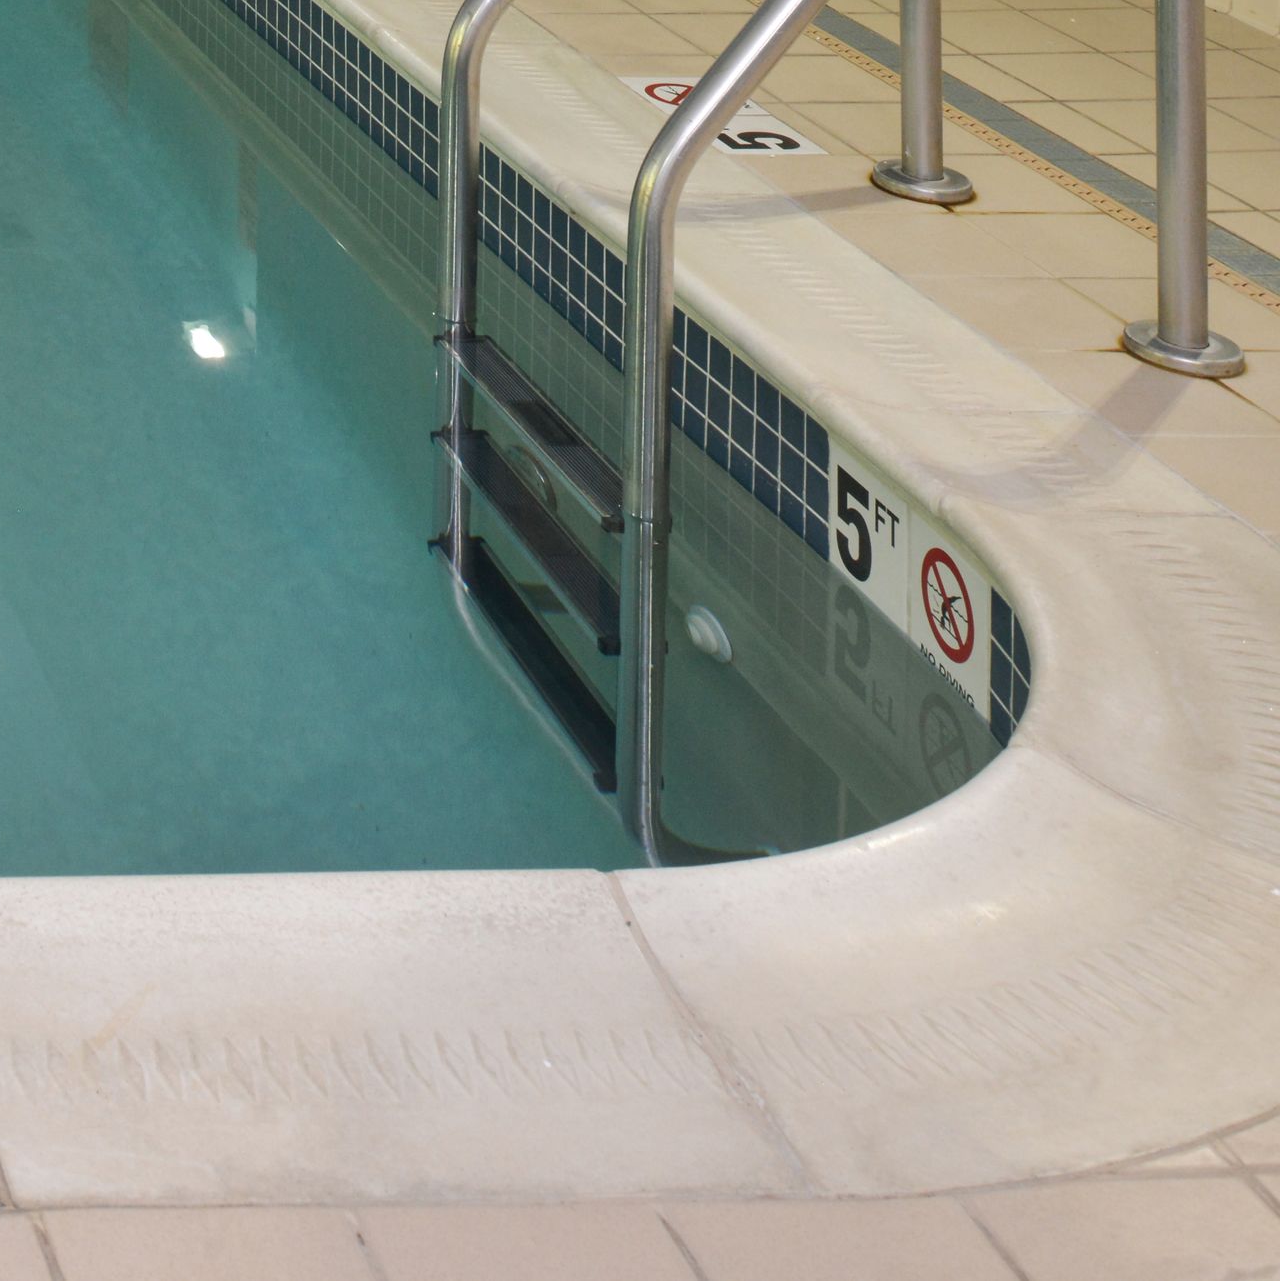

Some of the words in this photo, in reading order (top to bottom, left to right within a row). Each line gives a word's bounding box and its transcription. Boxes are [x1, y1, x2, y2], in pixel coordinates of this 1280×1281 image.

[716, 131, 801, 150] 5
[836, 464, 873, 583] 5
[874, 497, 900, 549] FT
[919, 642, 937, 667] NO
[937, 661, 976, 710] DIVING
